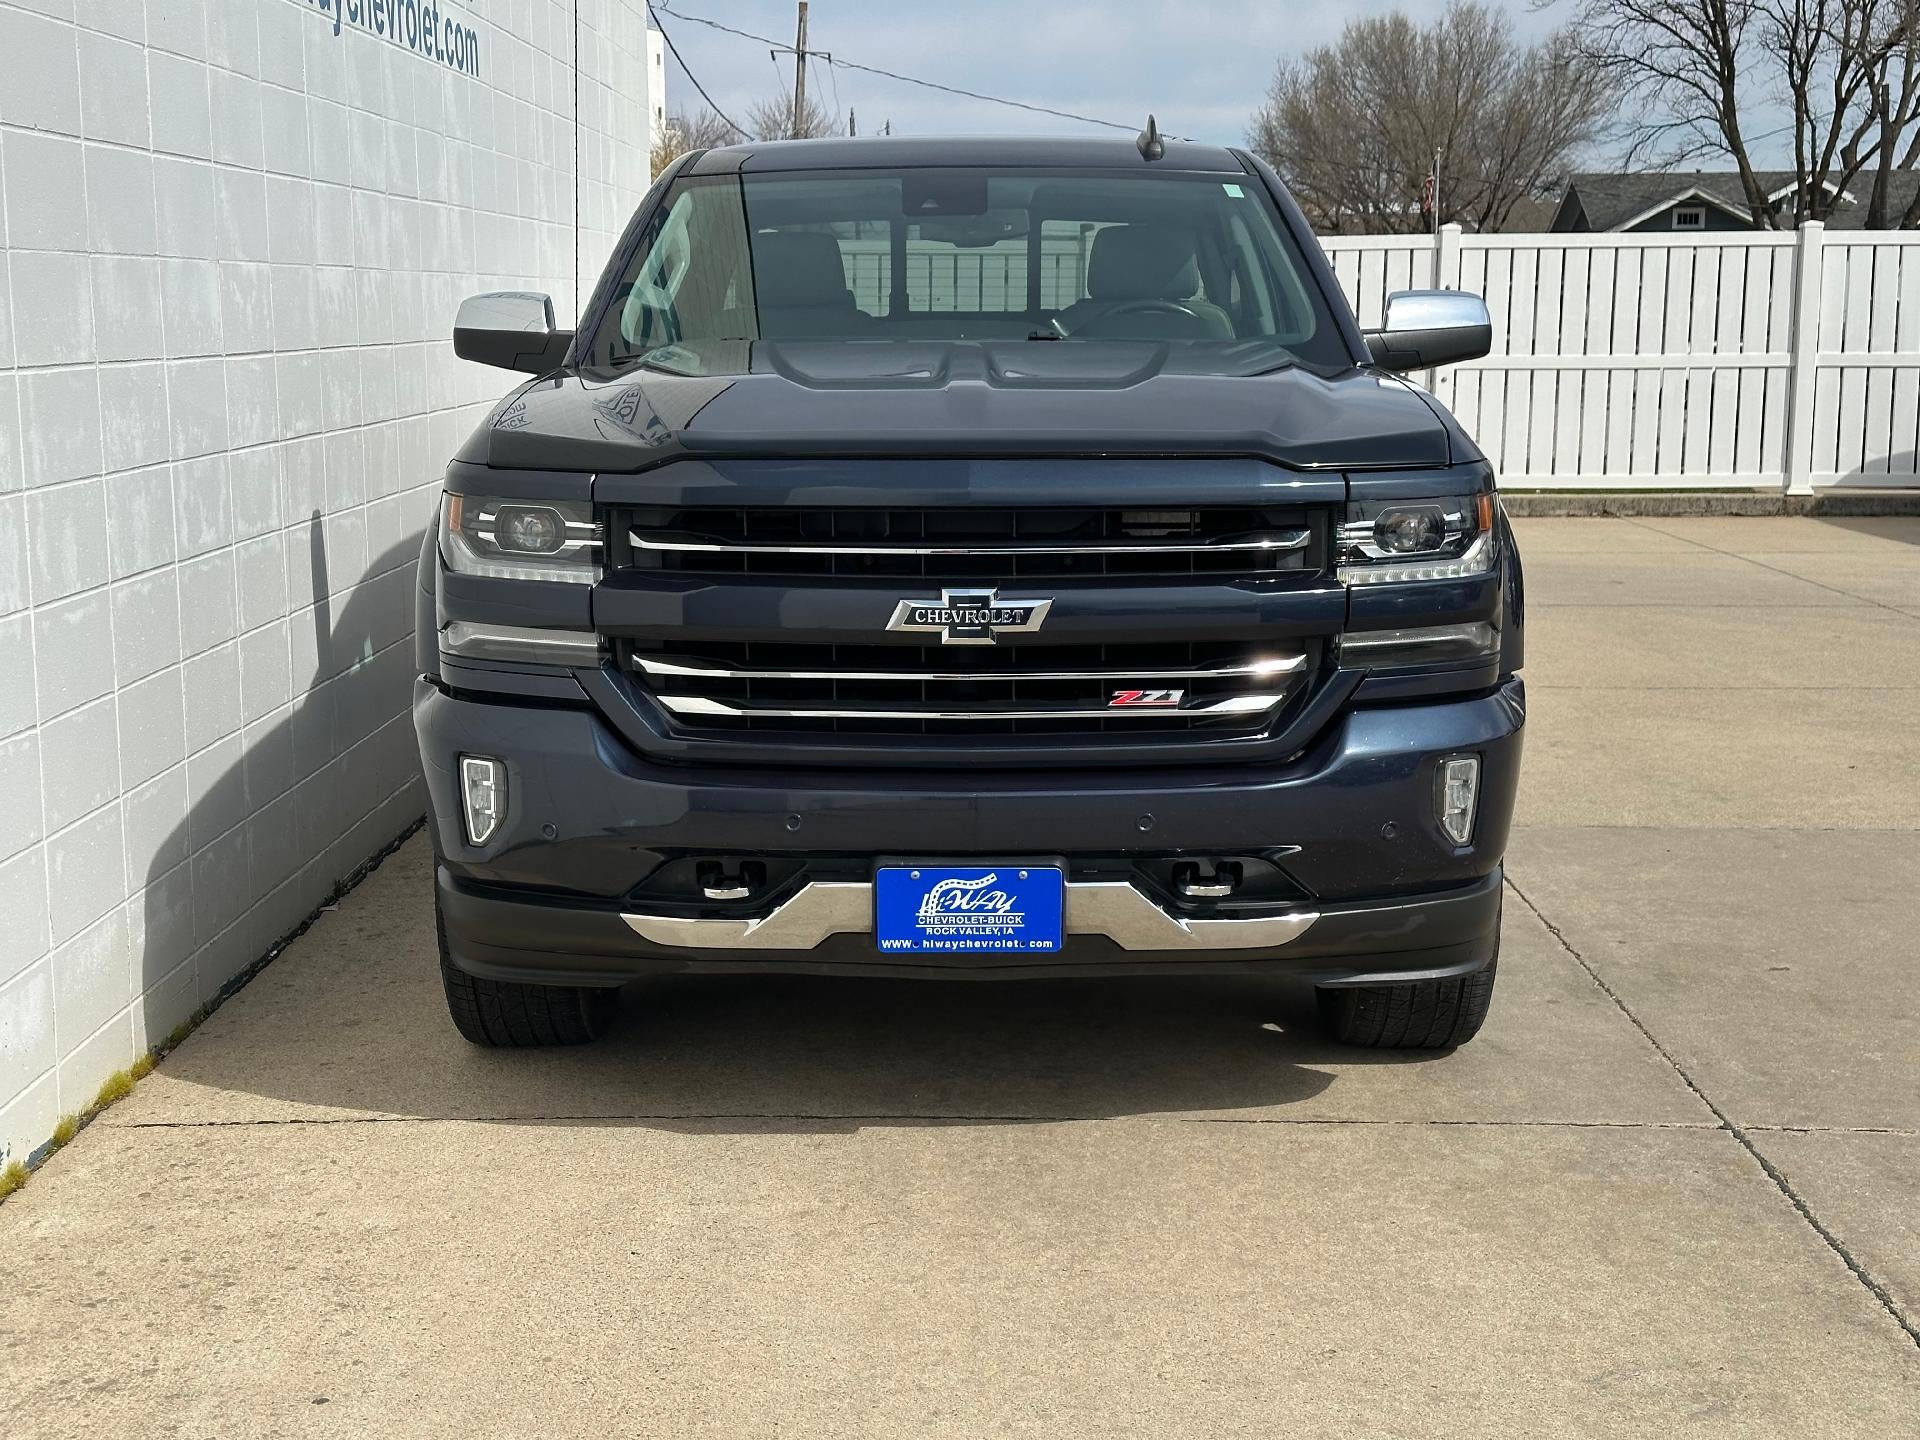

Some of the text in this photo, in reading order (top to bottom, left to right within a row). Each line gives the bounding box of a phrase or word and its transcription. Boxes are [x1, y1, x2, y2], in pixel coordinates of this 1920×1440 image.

[915, 609, 1024, 624] CHEVROLET
[1107, 689, 1184, 706] Z71
[918, 916, 1022, 924] CHEVROLET-BUICK
[926, 927, 1014, 936] ROCK VALLEY, IA
